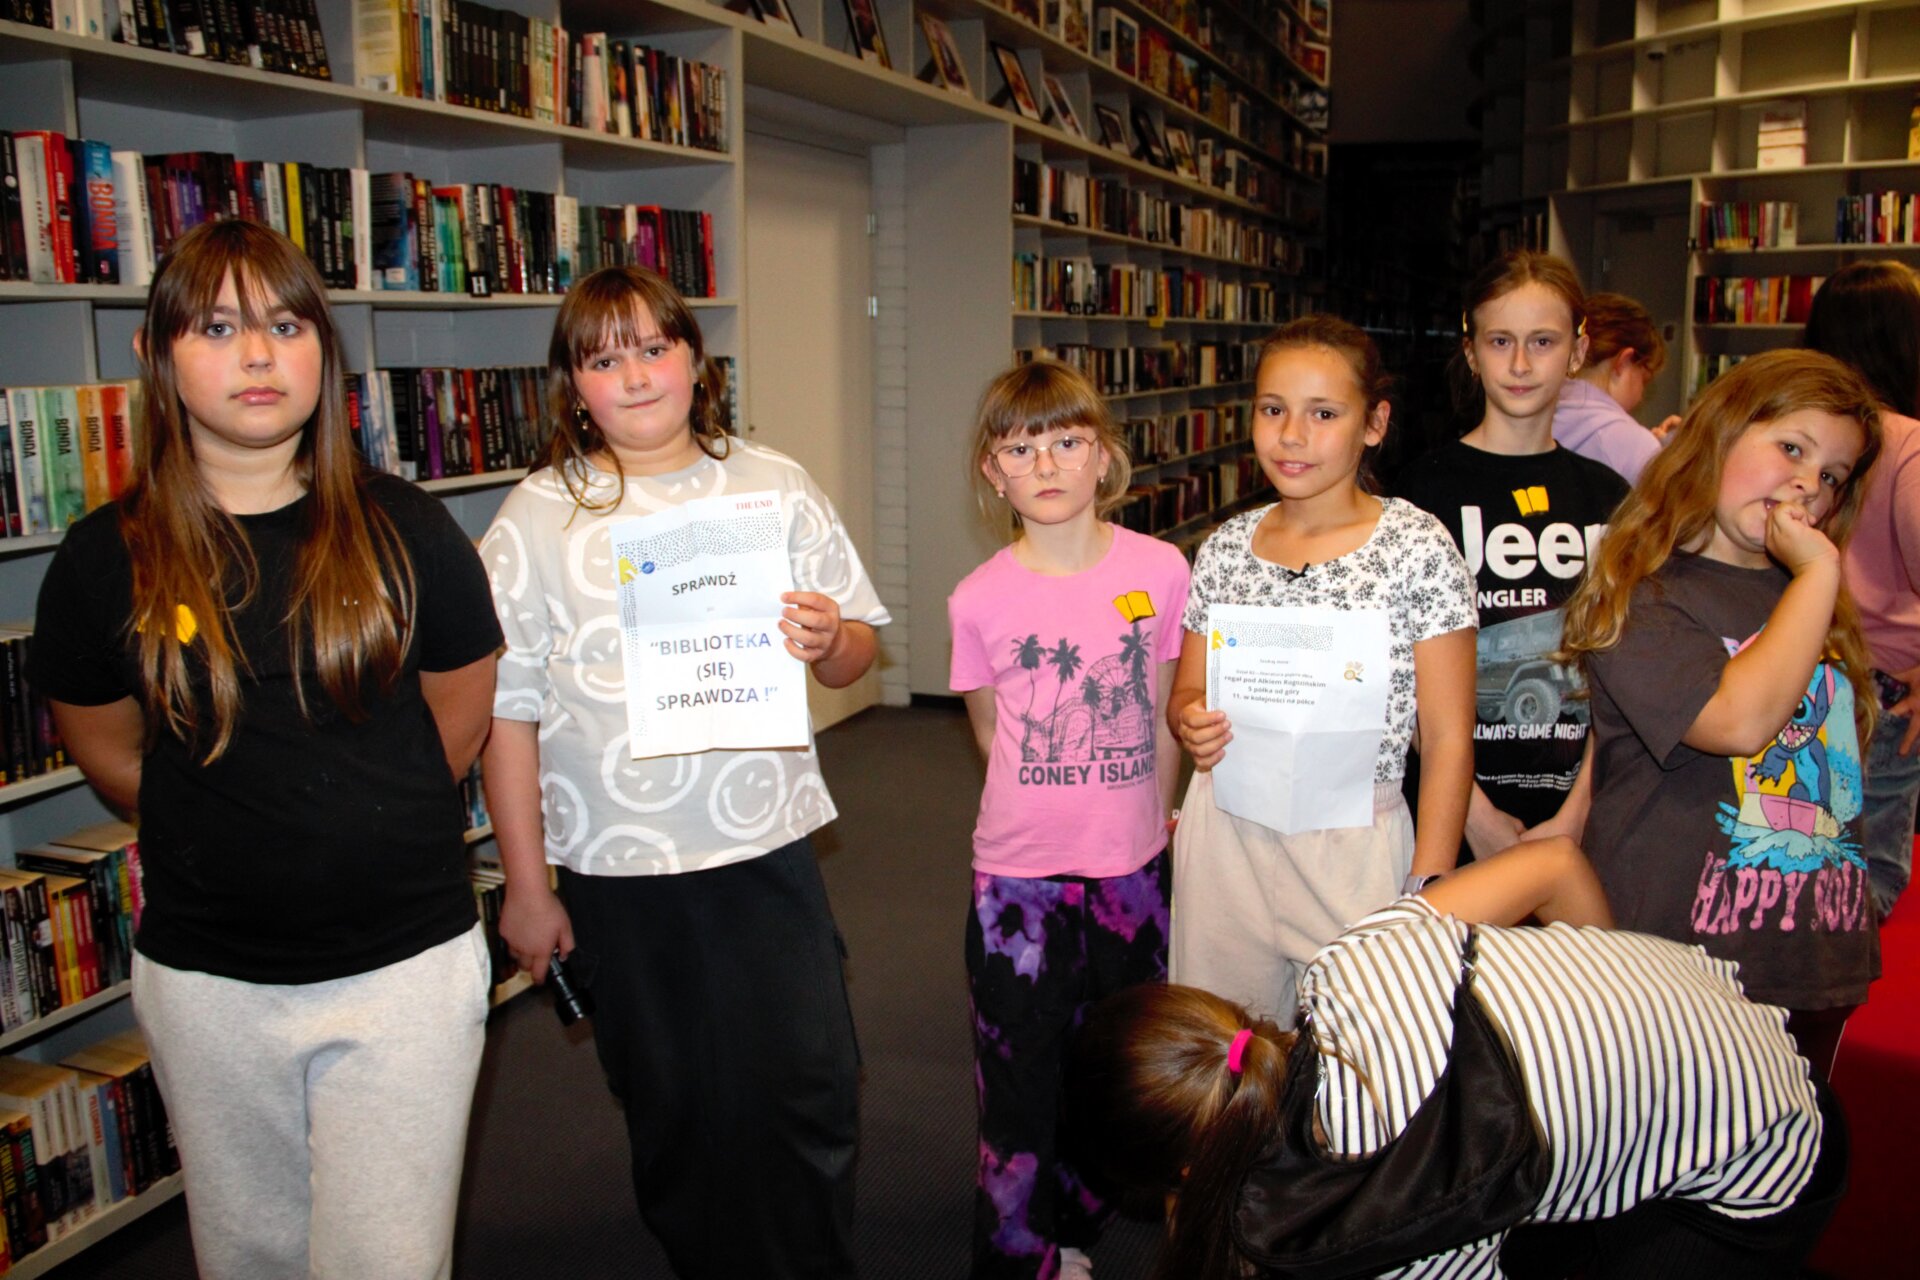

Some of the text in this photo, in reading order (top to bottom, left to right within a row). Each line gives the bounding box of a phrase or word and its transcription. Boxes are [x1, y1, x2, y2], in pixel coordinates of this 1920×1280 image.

[88, 182, 118, 250] BONDA
[471, 276, 487, 294] H
[19, 420, 37, 459] BONDA
[54, 418, 72, 456] BONDA
[86, 416, 102, 453] BONDA
[111, 415, 125, 449] BONDA
[736, 499, 773, 510] THE END
[671, 571, 737, 596] SPRAWDŹ
[696, 661, 735, 682] (SIĘ)
[656, 688, 759, 711] SPRAWDZA
[1250, 693, 1285, 704] kolejności
[1285, 688, 1300, 696] góry
[1518, 723, 1552, 740] GAME
[1554, 723, 1588, 740] NIGHT
[1019, 765, 1092, 785] CONEY
[1690, 851, 1808, 935] HAPPY
